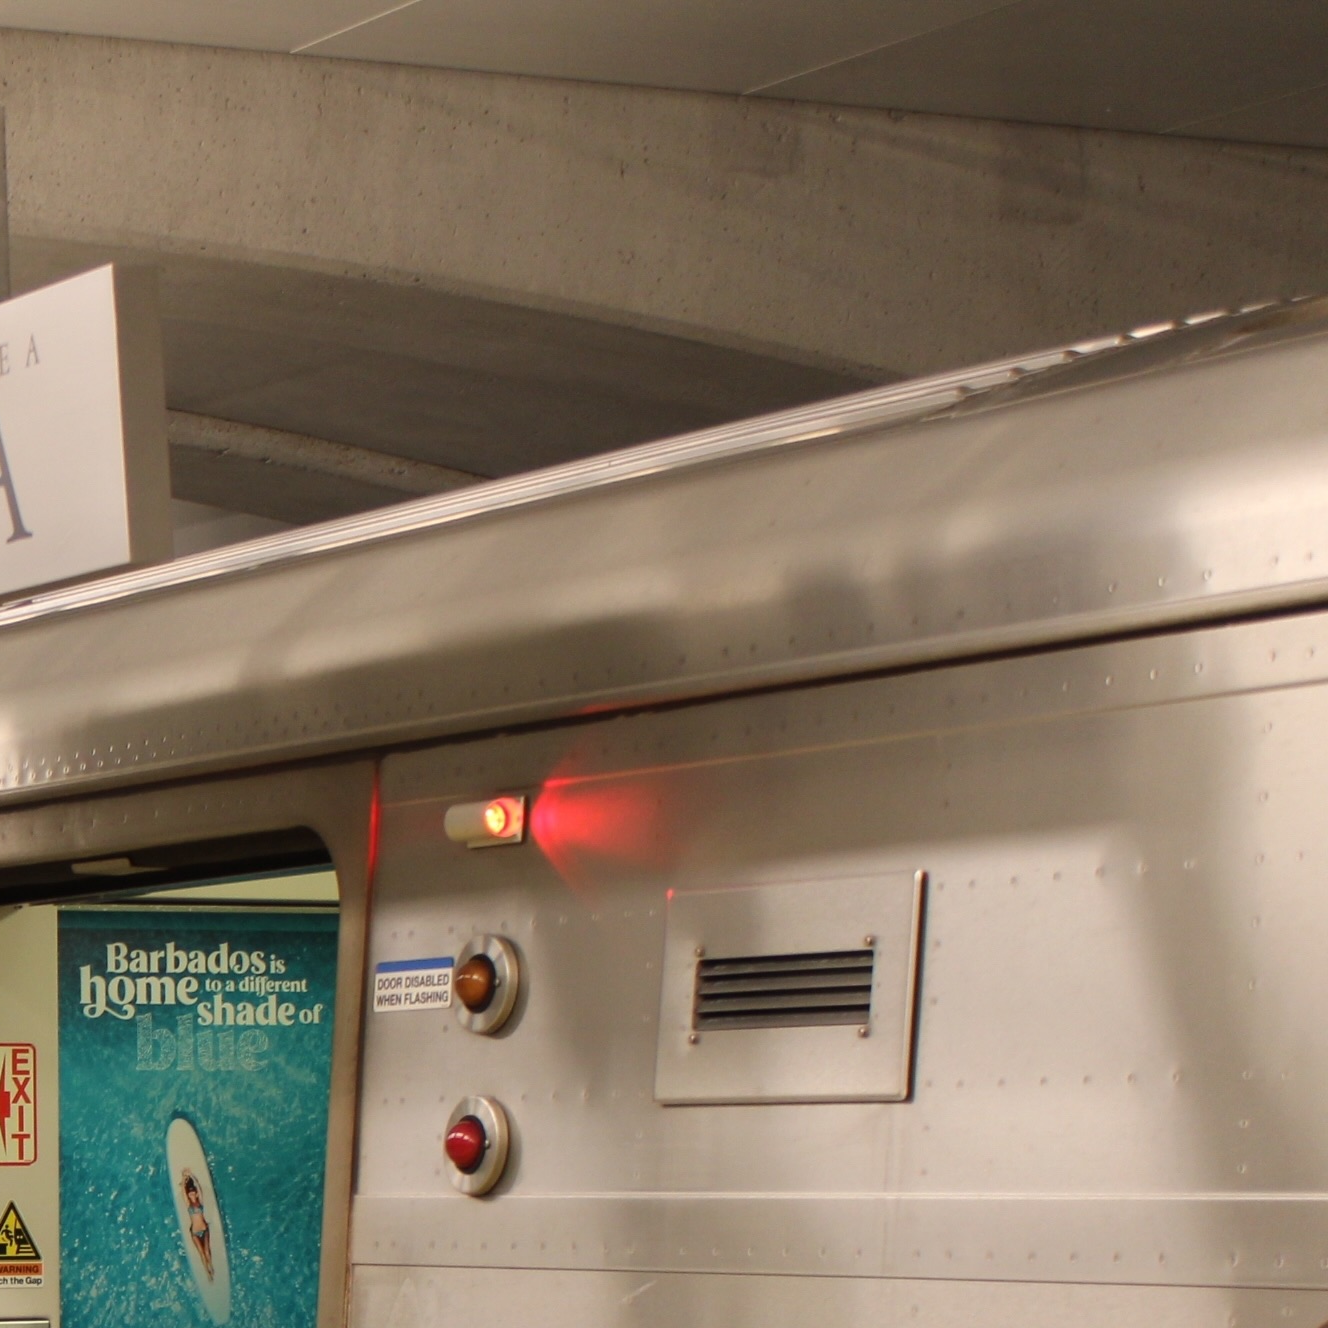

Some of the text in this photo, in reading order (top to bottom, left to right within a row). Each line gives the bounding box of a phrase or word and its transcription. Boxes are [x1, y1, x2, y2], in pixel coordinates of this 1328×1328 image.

[106, 941, 286, 975] Barbados is
[79, 964, 308, 1020] home to a different
[376, 991, 449, 1007] WHEN FLASHING
[377, 974, 450, 991] DOOR DISABLED
[197, 994, 324, 1026] shade of
[135, 1012, 270, 1072] blue
[11, 1048, 32, 1160] EXIT
[10, 1276, 24, 1285] the
[25, 1276, 42, 1287] Gap
